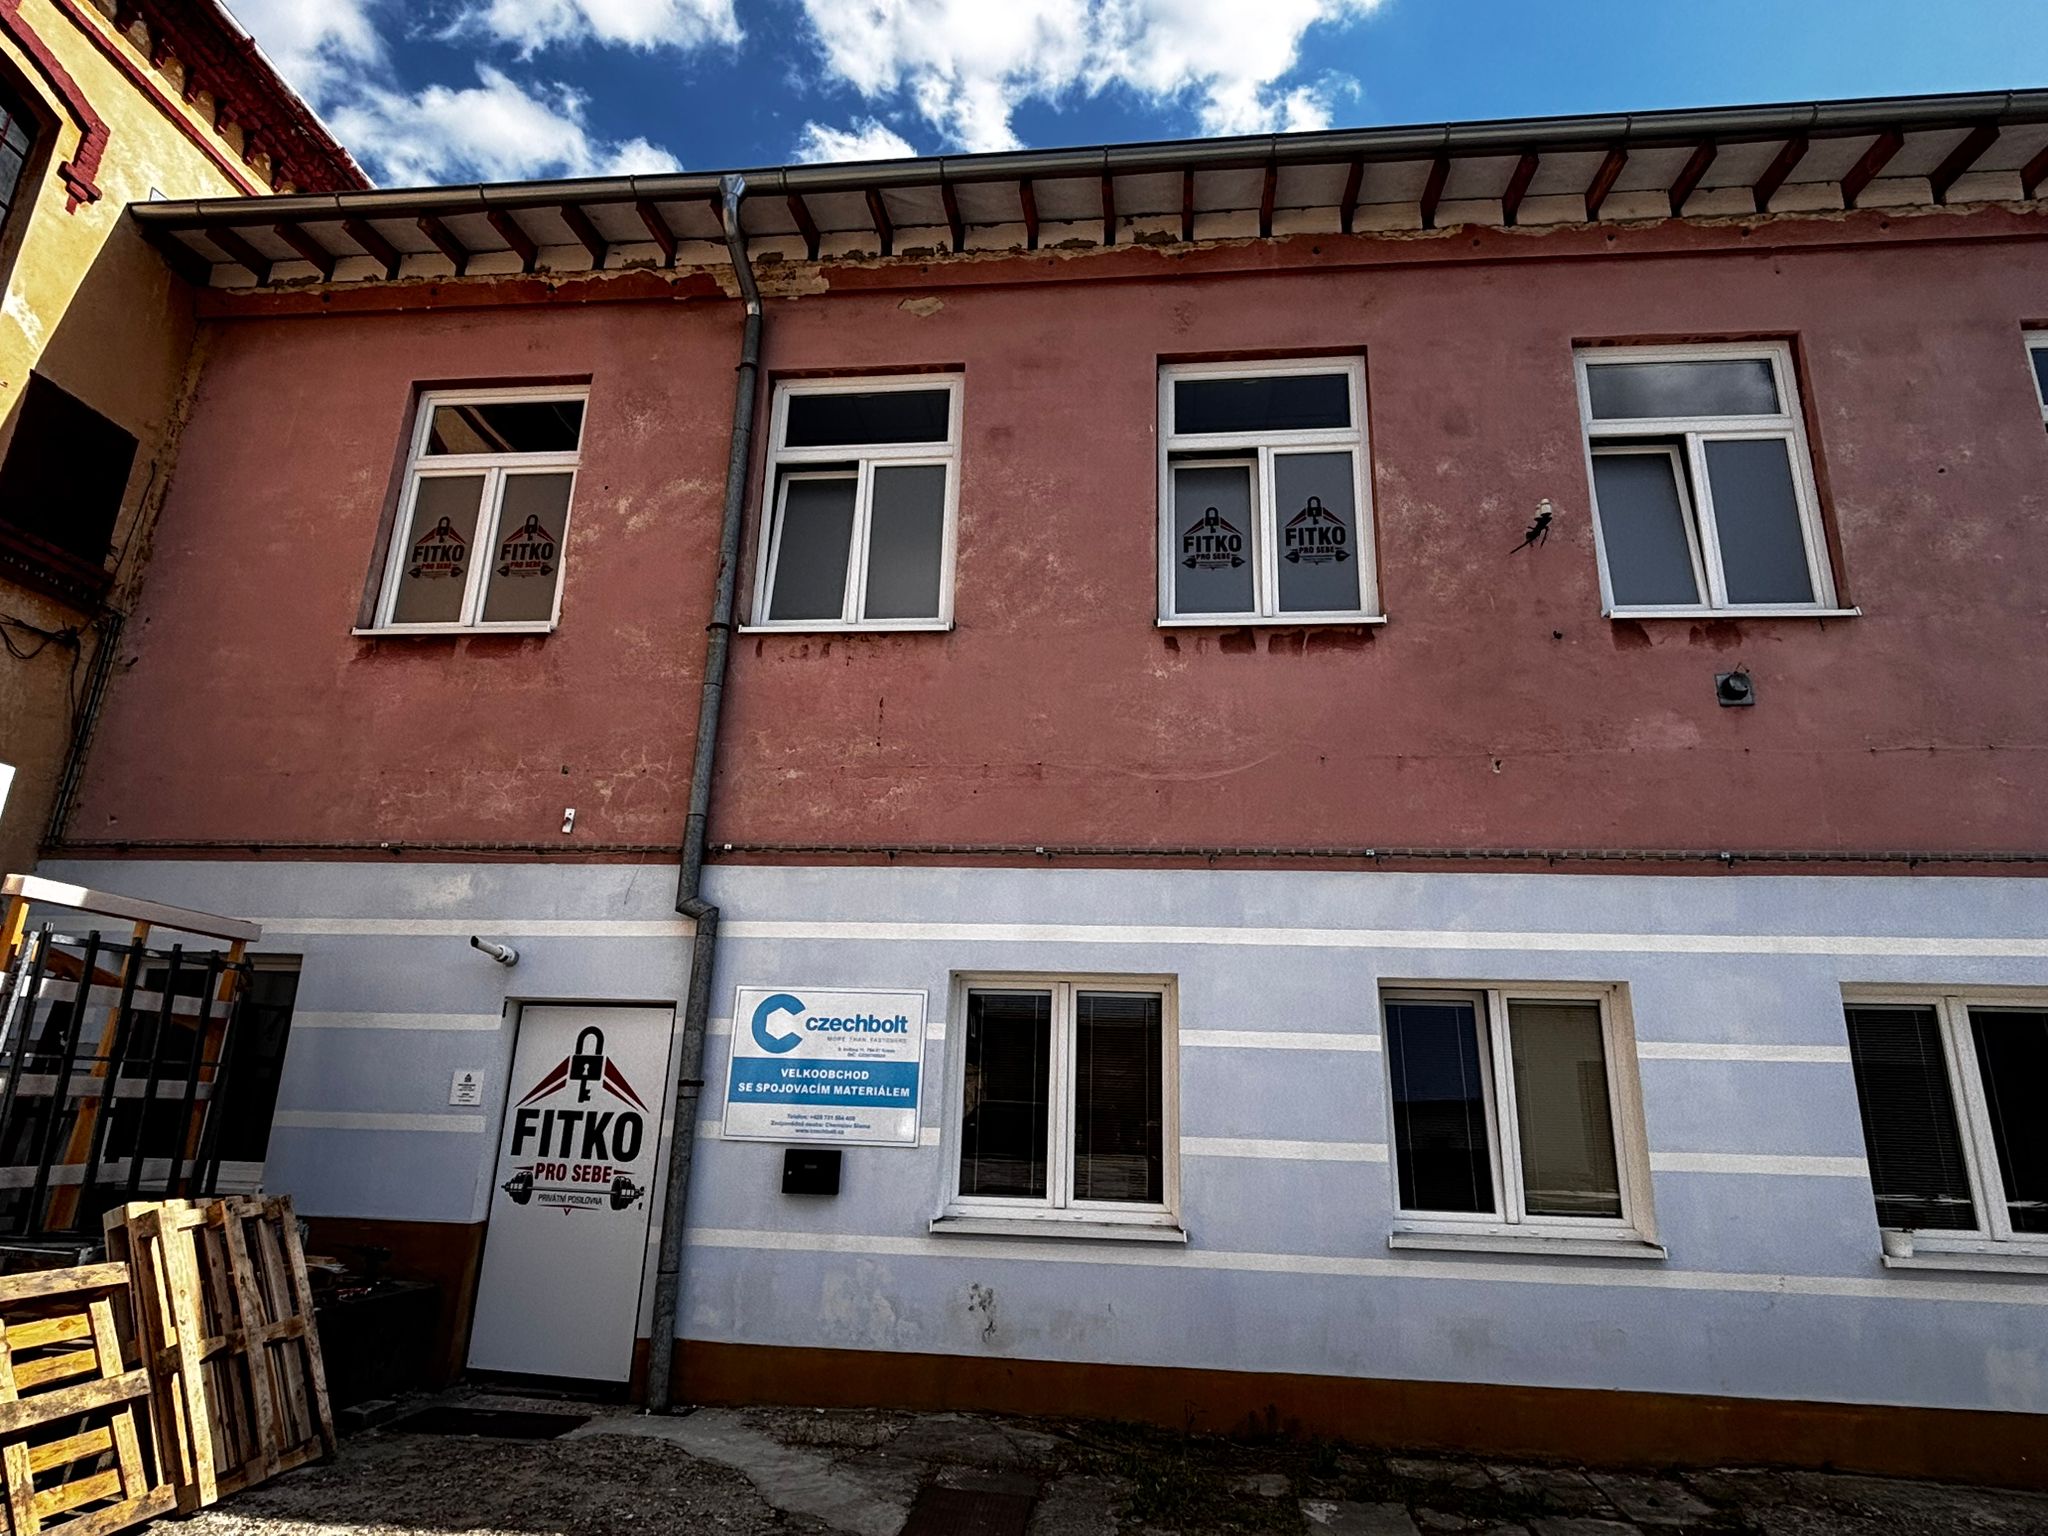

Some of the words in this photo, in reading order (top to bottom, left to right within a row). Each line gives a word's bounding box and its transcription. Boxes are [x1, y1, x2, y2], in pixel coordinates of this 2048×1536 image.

[1183, 534, 1242, 553] FITKO
[1285, 526, 1346, 546] FITKO
[412, 544, 465, 562] FITKO
[500, 543, 554, 561] FITKO
[805, 1014, 908, 1034] czechbolt
[781, 1068, 869, 1080] VELKOOBCHOD
[738, 1082, 752, 1092] SE
[755, 1083, 830, 1095] SPOJOVACÍM
[833, 1085, 910, 1097] MATERIÁLEM
[510, 1108, 643, 1162] FITKO
[534, 1163, 567, 1182] PRO
[571, 1164, 613, 1184] SEBE
